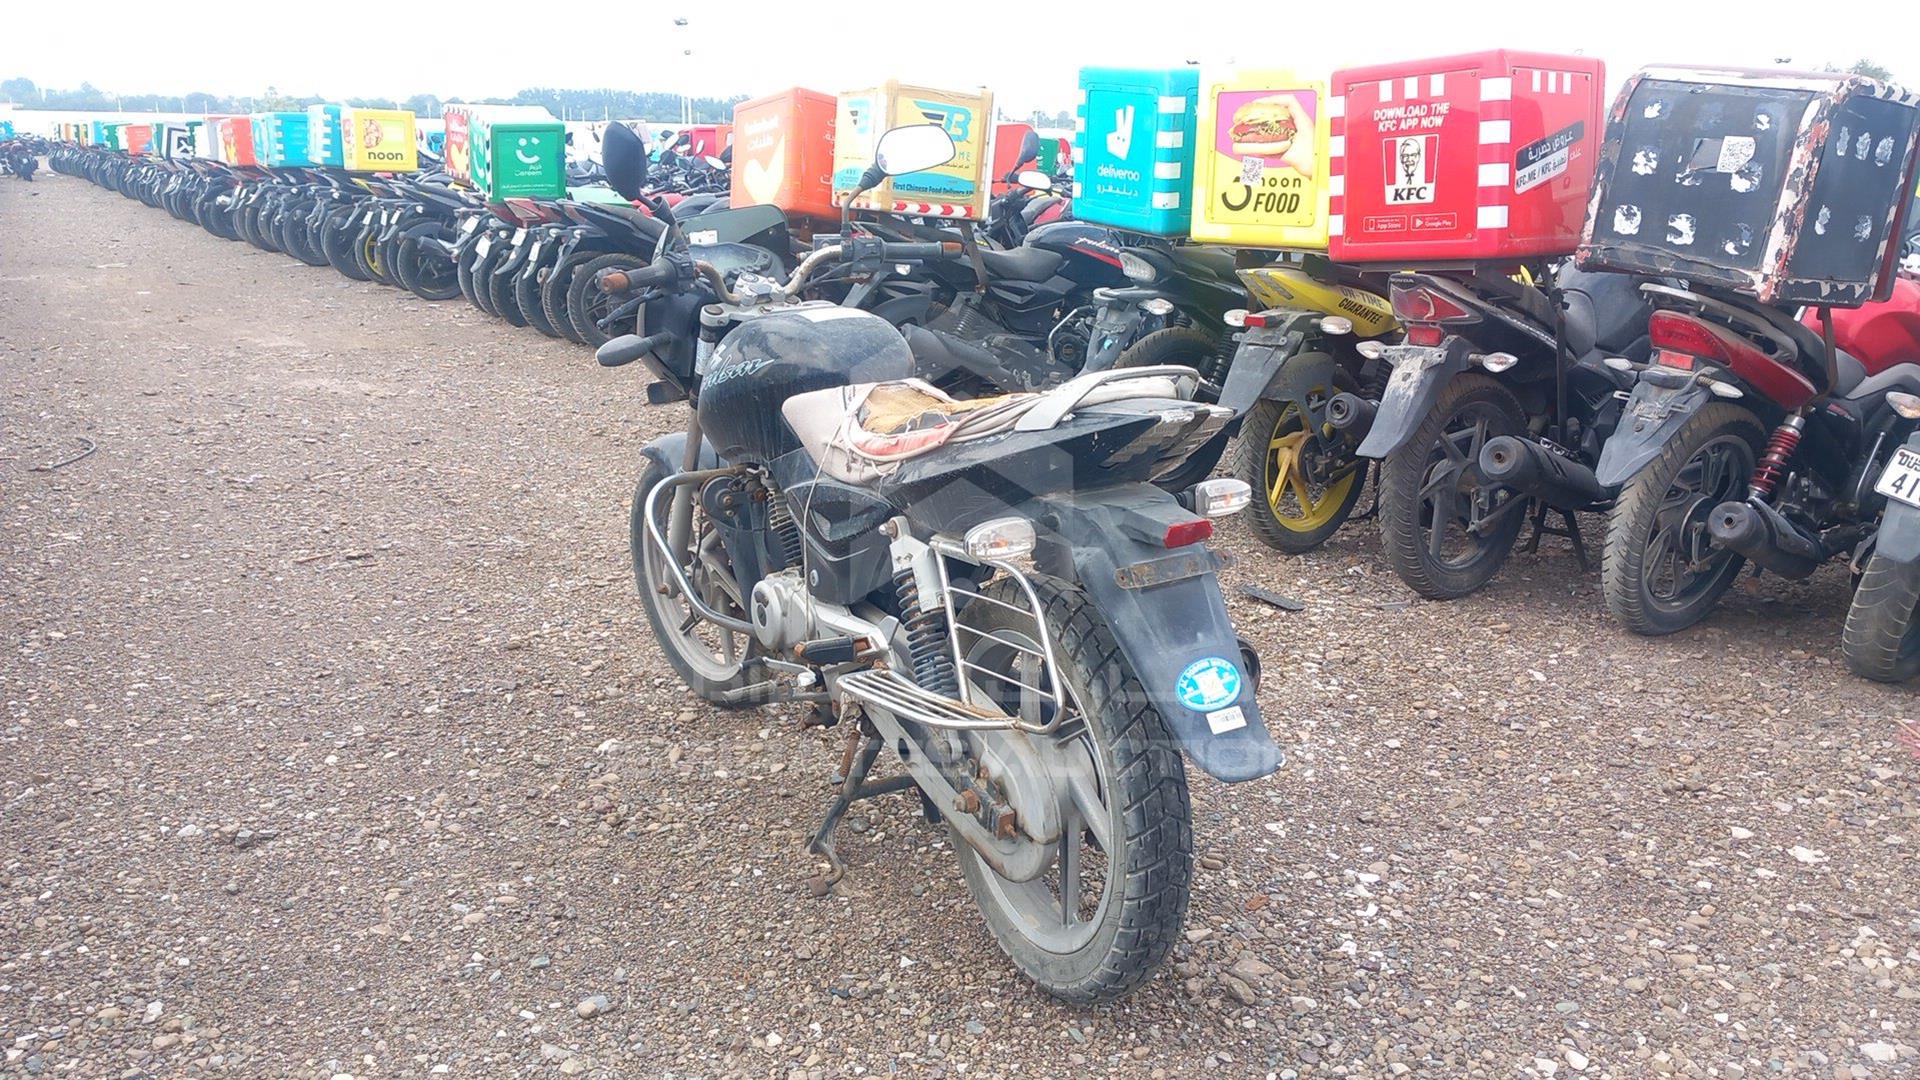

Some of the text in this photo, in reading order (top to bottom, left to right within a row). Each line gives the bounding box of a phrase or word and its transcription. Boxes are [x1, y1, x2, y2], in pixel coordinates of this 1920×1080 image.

[1373, 102, 1451, 121] DOWNLOAD THE
[1378, 115, 1445, 133] KFC APP NOW
[367, 150, 404, 161] noon
[1096, 163, 1141, 181] deliveroo
[892, 181, 906, 191] First
[906, 183, 928, 192] Chinese
[928, 185, 943, 194] Food
[1392, 186, 1428, 202] KFC
[1253, 192, 1301, 214] FOOD
[1341, 287, 1385, 311] ON-TIME
[1338, 297, 1384, 326] GUARANTEE
[1891, 473, 1920, 501] 41
